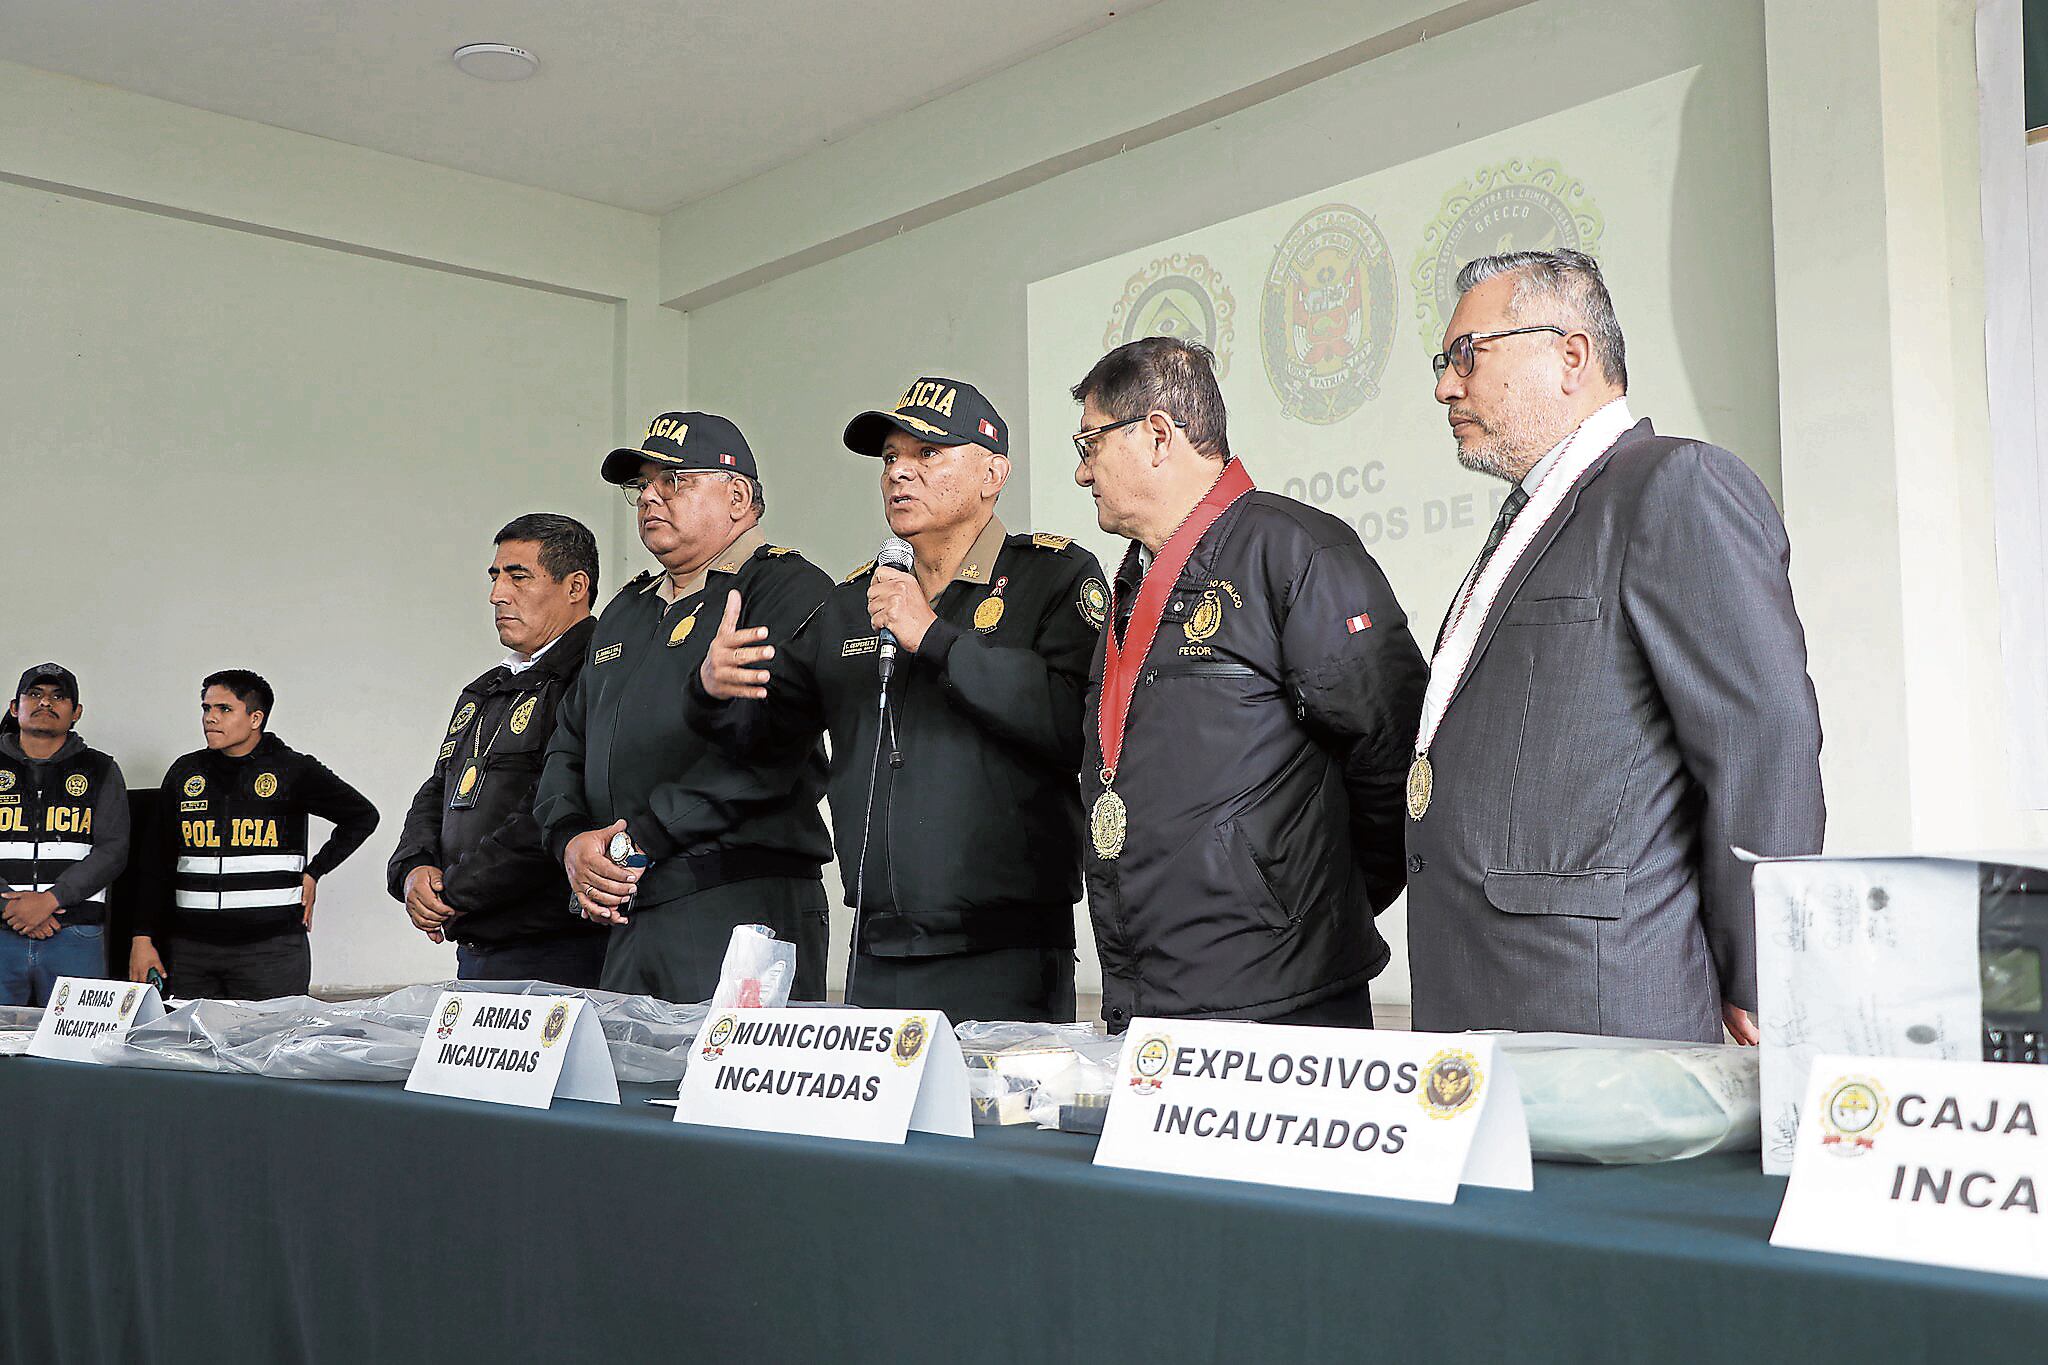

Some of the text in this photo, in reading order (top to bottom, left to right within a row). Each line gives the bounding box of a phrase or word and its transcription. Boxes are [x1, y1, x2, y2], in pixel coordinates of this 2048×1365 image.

[1474, 206, 1529, 232] GRECCO
[899, 381, 957, 418] LICIA
[646, 419, 689, 446] ICIA
[1351, 507, 1409, 545] OS
[1423, 493, 1474, 534] DE
[1178, 646, 1212, 656] FECOR
[78, 989, 116, 1008] ARMAS
[472, 1006, 532, 1031] ARMAS
[731, 1021, 893, 1053] MUNICIONES
[437, 1043, 540, 1073] INCAUTADAS
[1172, 1046, 1419, 1094] EXPLOSIVOS
[714, 1065, 881, 1102] INCAUTADAS
[1153, 1103, 1408, 1154] INCAUTADOS
[1896, 1093, 2038, 1136] CAJA
[1890, 1165, 2040, 1214] INCA
